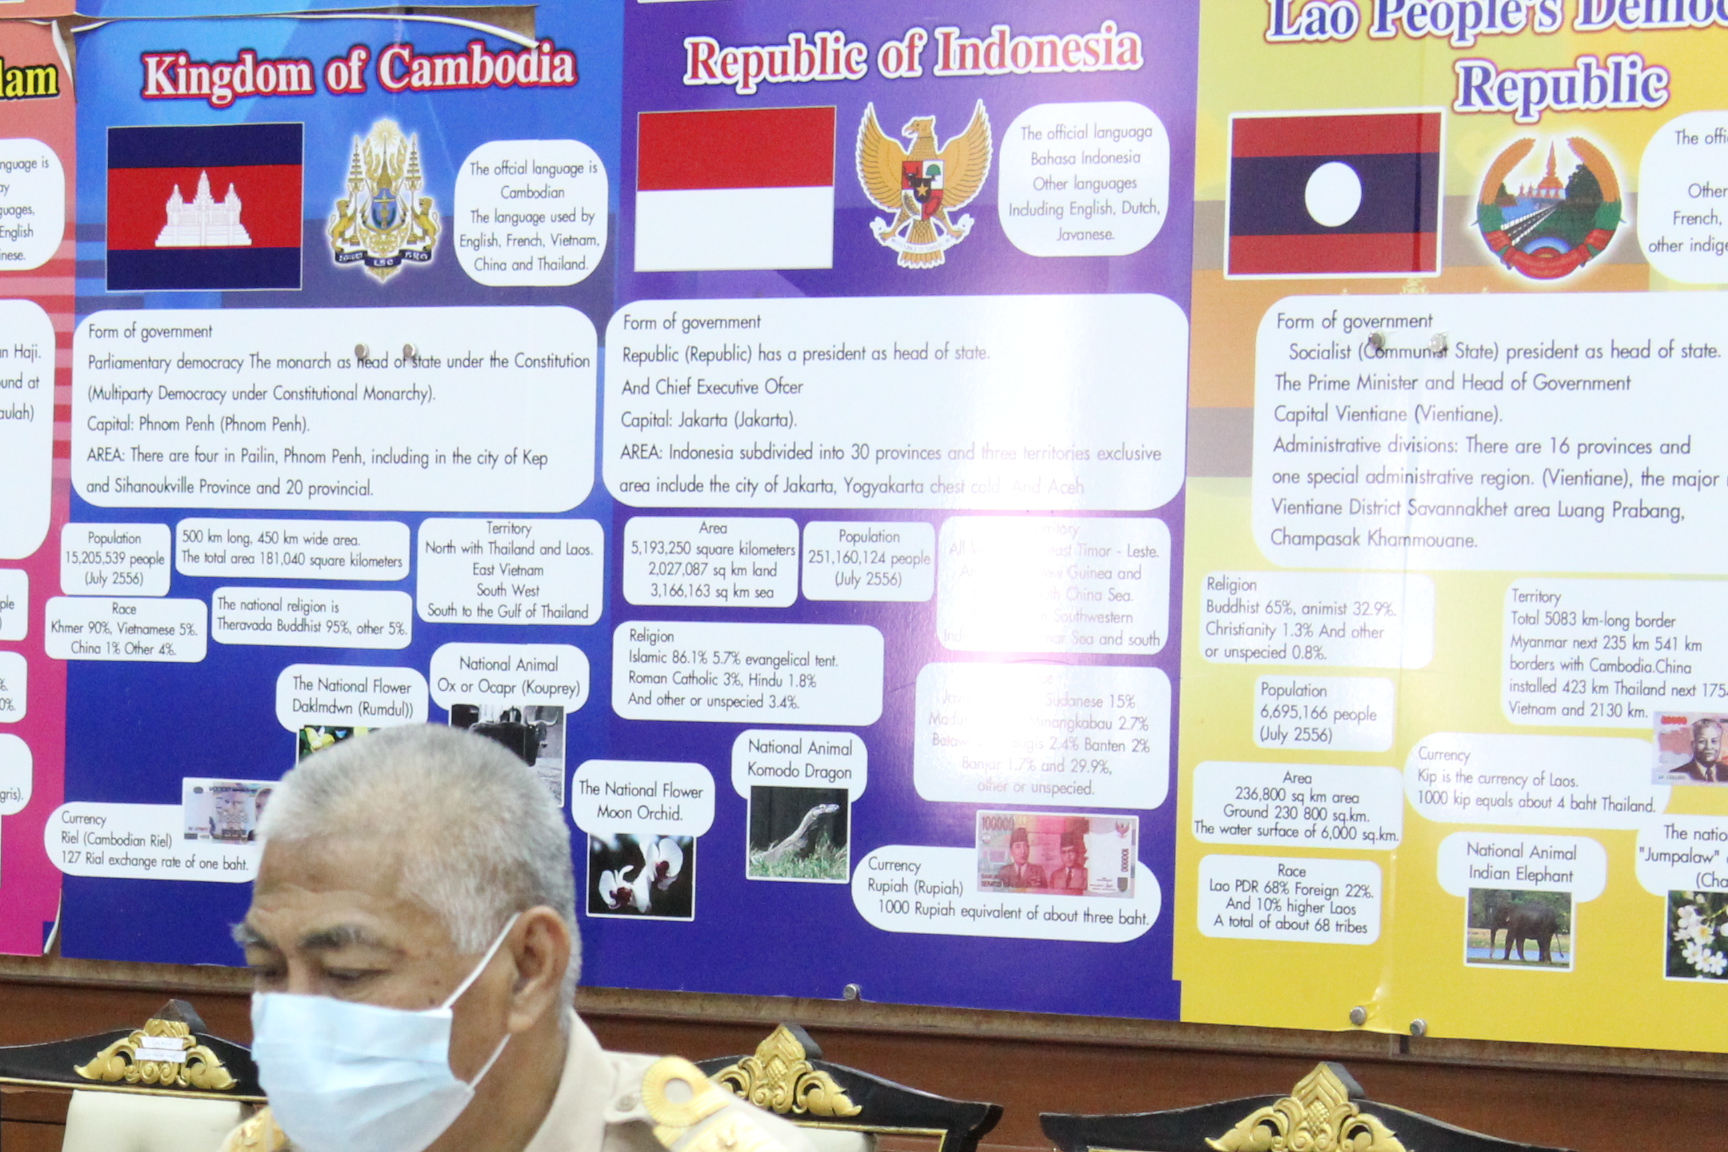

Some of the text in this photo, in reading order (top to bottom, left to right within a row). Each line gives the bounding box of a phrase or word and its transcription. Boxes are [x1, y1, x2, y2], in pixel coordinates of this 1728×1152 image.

[1268, 0, 1356, 39] Lao
[1373, 0, 1559, 43] People's
[683, 22, 1143, 91] Republic of Indonesia
[144, 41, 576, 104] Kingdom of Cambodia
[1455, 58, 1668, 120] Republic
[1031, 147, 1141, 166] Bahasa Indonesia
[500, 183, 565, 200] Cambodian
[1032, 174, 1138, 195] Other languages
[1008, 197, 1161, 221] Including English, Dutch,
[459, 231, 601, 253] English, French, Vietnam,
[1056, 226, 1115, 242] Javanese.
[473, 254, 590, 273] China and Thailand.
[88, 321, 213, 344] Form of government
[623, 311, 762, 335] Form of government
[1277, 311, 1434, 335] Form of government
[14, 343, 42, 364] Haji.
[87, 382, 436, 406] (Multiparty Democracy under Constitutional Monarchy).
[87, 413, 310, 436] Capital: Phnom Penh (Phnom Penh).
[620, 409, 797, 433] Capital: Jakarta (Jakarta).
[1274, 403, 1503, 427] Capital Vientiane (Vientiane).
[1272, 497, 1685, 524] Vientiane District Savannakhet area Luang Prabang,
[839, 527, 900, 547] Population
[1270, 527, 1478, 551] Champasak Khammouane.
[472, 561, 544, 577] East Vietnam
[808, 549, 886, 566] 251,160,124
[890, 549, 931, 569] people
[1207, 574, 1257, 596] Religion
[1511, 587, 1562, 608] Territory
[629, 626, 675, 647] Religion
[459, 654, 559, 673] National Animal
[293, 674, 412, 695] The National Flower
[1260, 703, 1377, 725] 6,695,166 people
[748, 737, 853, 757] National Animal
[1417, 745, 1472, 767] Currency
[747, 760, 852, 784] Komodo Dragon
[580, 778, 704, 799] The National Flower
[61, 810, 107, 829] Currency
[596, 803, 683, 822] Moon Orchid.
[1467, 841, 1577, 861] National Animal
[868, 855, 922, 877] Currency
[1277, 862, 1307, 878] Race
[1469, 863, 1574, 887] Indian Elephant
[867, 876, 909, 896] Rupiah
[913, 879, 964, 899] (Rupiah)
